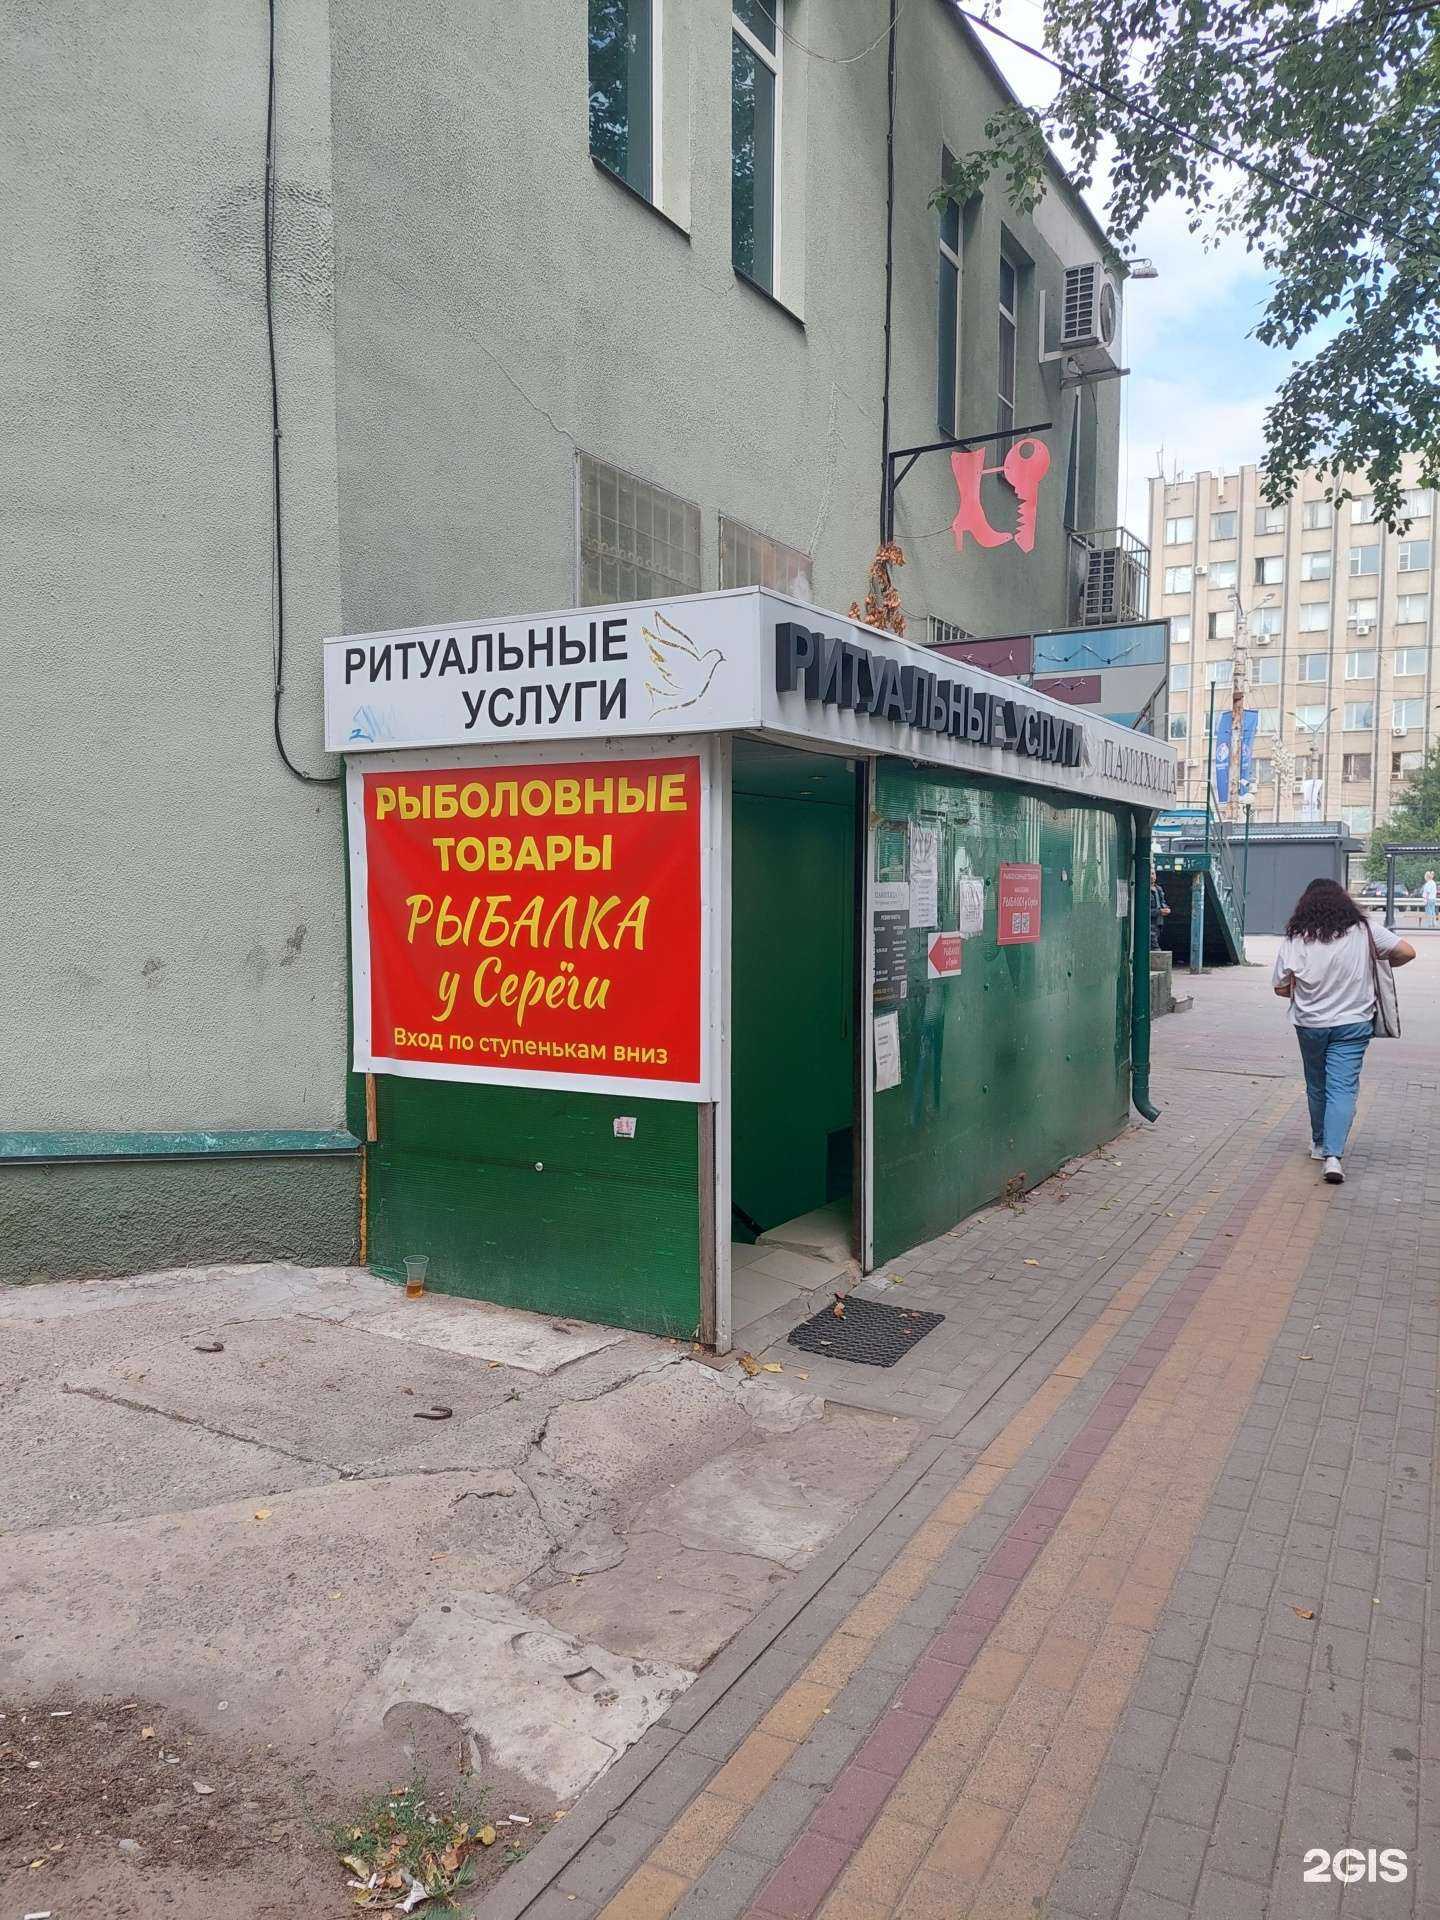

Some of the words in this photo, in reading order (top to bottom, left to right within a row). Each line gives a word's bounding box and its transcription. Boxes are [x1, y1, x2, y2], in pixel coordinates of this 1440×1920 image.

[345, 619, 628, 684] РИТУАЛЬНЫЕ
[462, 678, 627, 729] УСЛУГИ
[776, 622, 1005, 748] РИТУАЛЬНЫЕ
[1007, 701, 1082, 767] УСЛУГИ
[375, 773, 687, 820] РЫБОЛОВНЫЕ
[432, 834, 613, 872] ТОВАРЫ
[405, 894, 650, 951] РЫБАЛКА
[431, 971, 461, 1022] у
[473, 956, 611, 1026] Серёги
[394, 1027, 443, 1051] Вход
[449, 1034, 474, 1051] по
[479, 1037, 606, 1061] ступенькам
[614, 1045, 668, 1065] вниз
